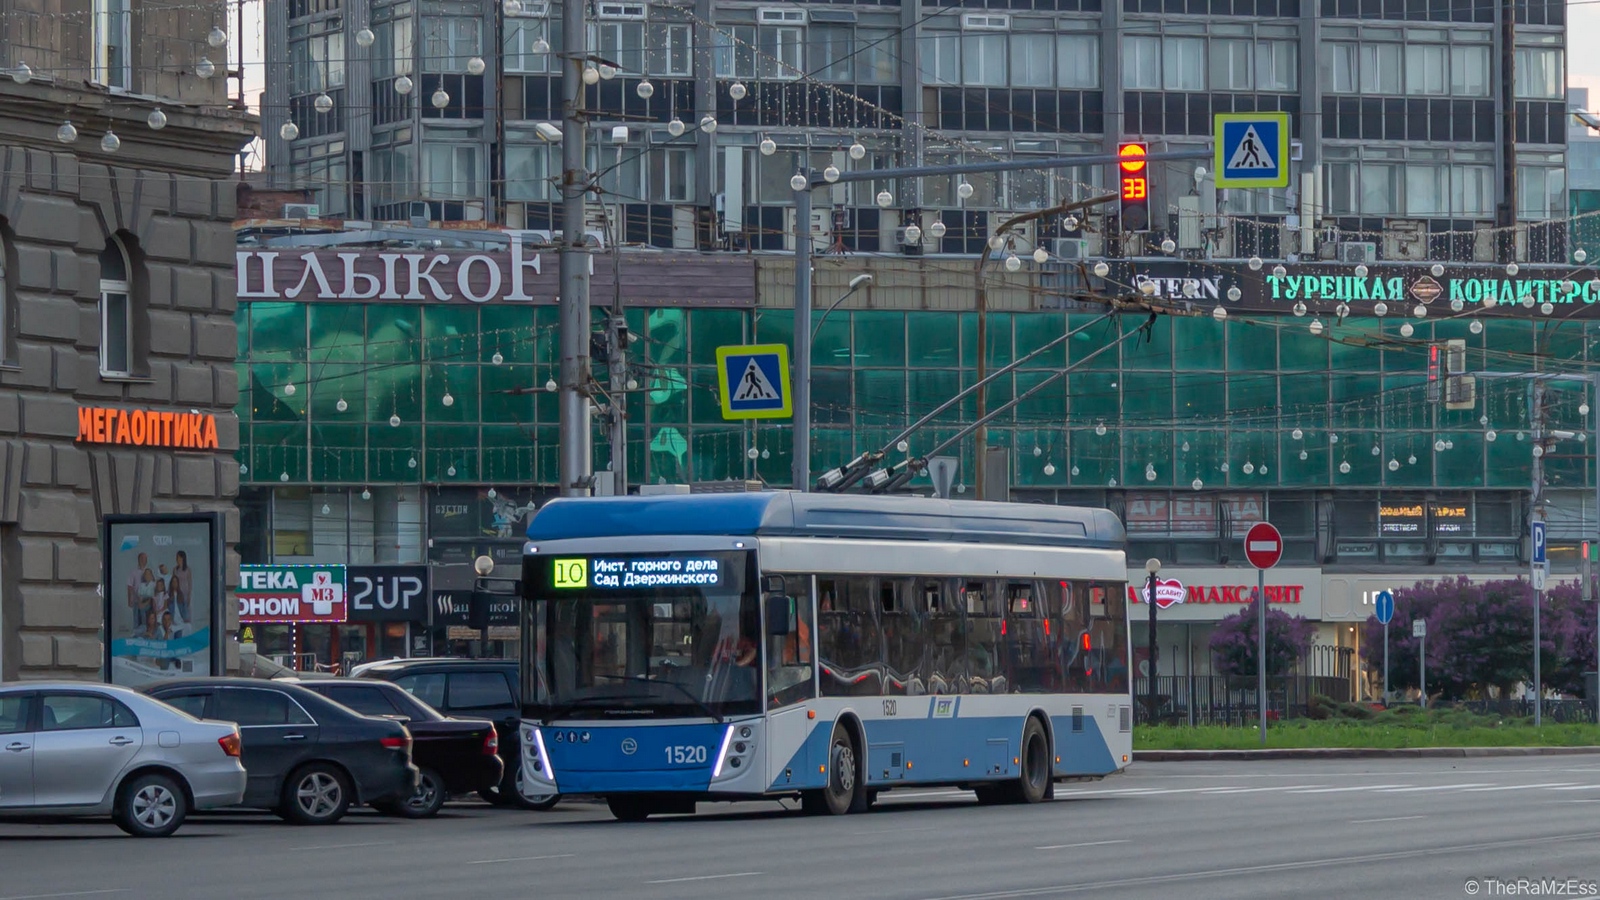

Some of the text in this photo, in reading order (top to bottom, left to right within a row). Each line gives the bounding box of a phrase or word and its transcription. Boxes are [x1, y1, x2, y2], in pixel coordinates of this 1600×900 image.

[1124, 178, 1145, 198] 33
[1266, 274, 1600, 306] ТУРЕЦКАЯ КОНДИТЕРС
[76, 406, 218, 449] МЕГАОПТИКА
[1535, 527, 1543, 558] P
[557, 563, 583, 583] 10
[594, 560, 718, 573] Инст. горного дела
[240, 571, 299, 589] ТЕКА
[594, 573, 718, 587] Сад Дзержинского
[882, 699, 897, 716] 1520
[665, 745, 707, 763] 1520
